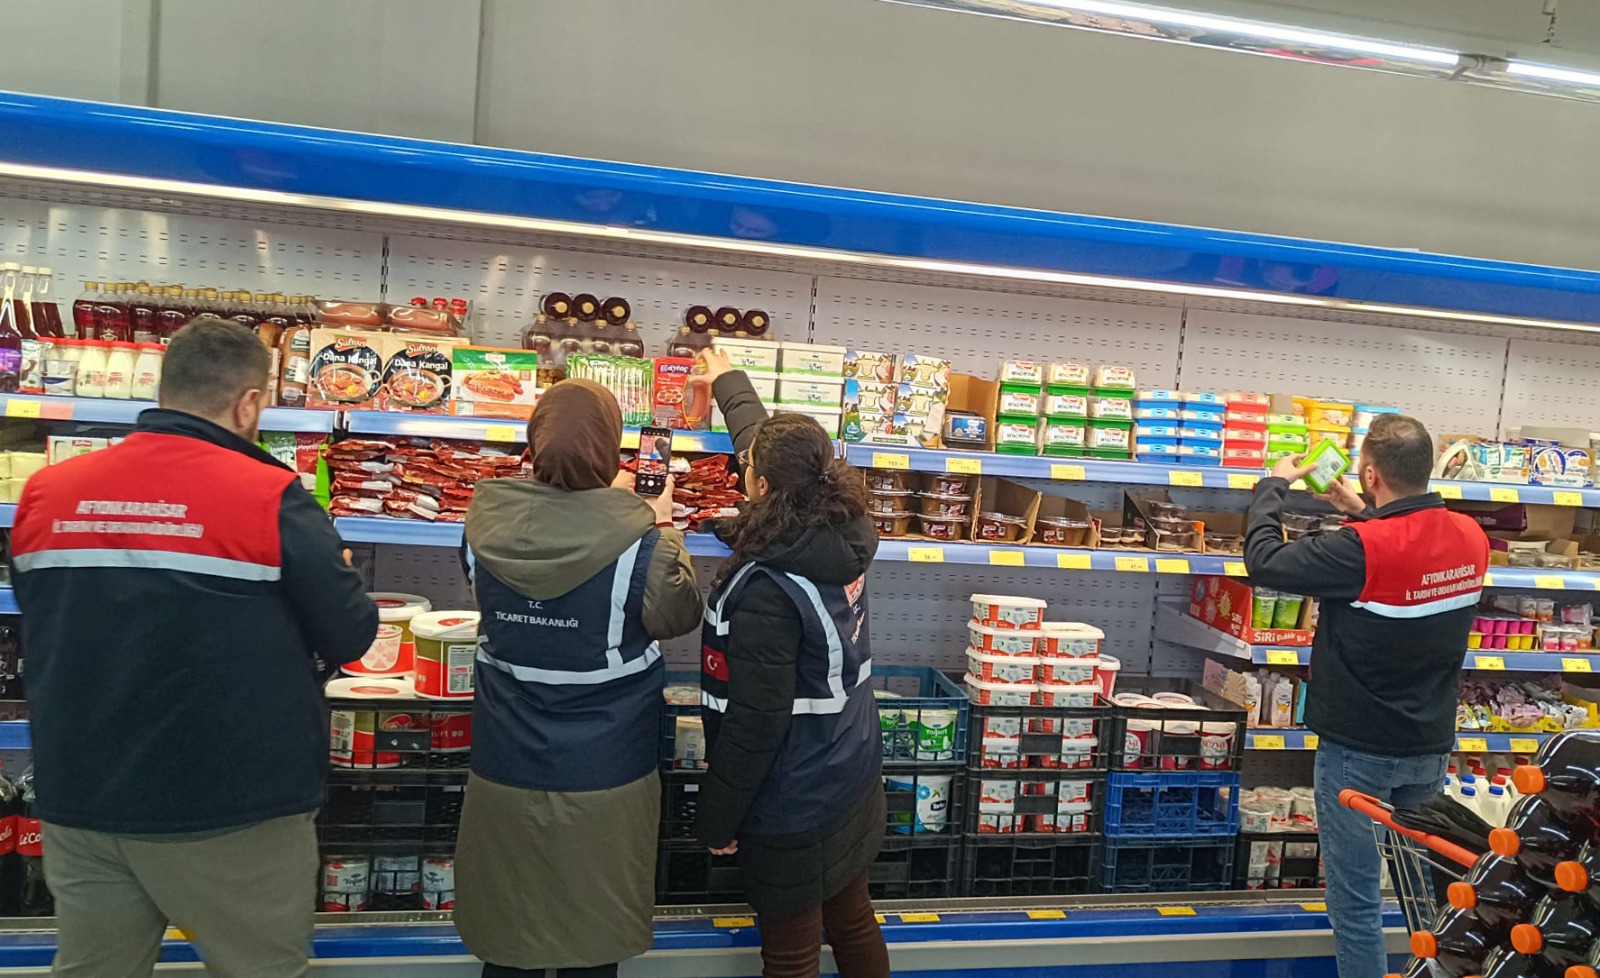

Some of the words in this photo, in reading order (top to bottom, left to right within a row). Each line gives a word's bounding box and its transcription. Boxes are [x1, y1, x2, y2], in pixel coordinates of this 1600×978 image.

[336, 338, 366, 348] Sultan
[407, 344, 437, 354] Sultan
[418, 361, 448, 371] Kangal
[528, 601, 543, 609] T.C.
[495, 611, 529, 624] TİCARET
[529, 616, 579, 628] BAKANLIĞI
[1254, 632, 1275, 642] SiRi
